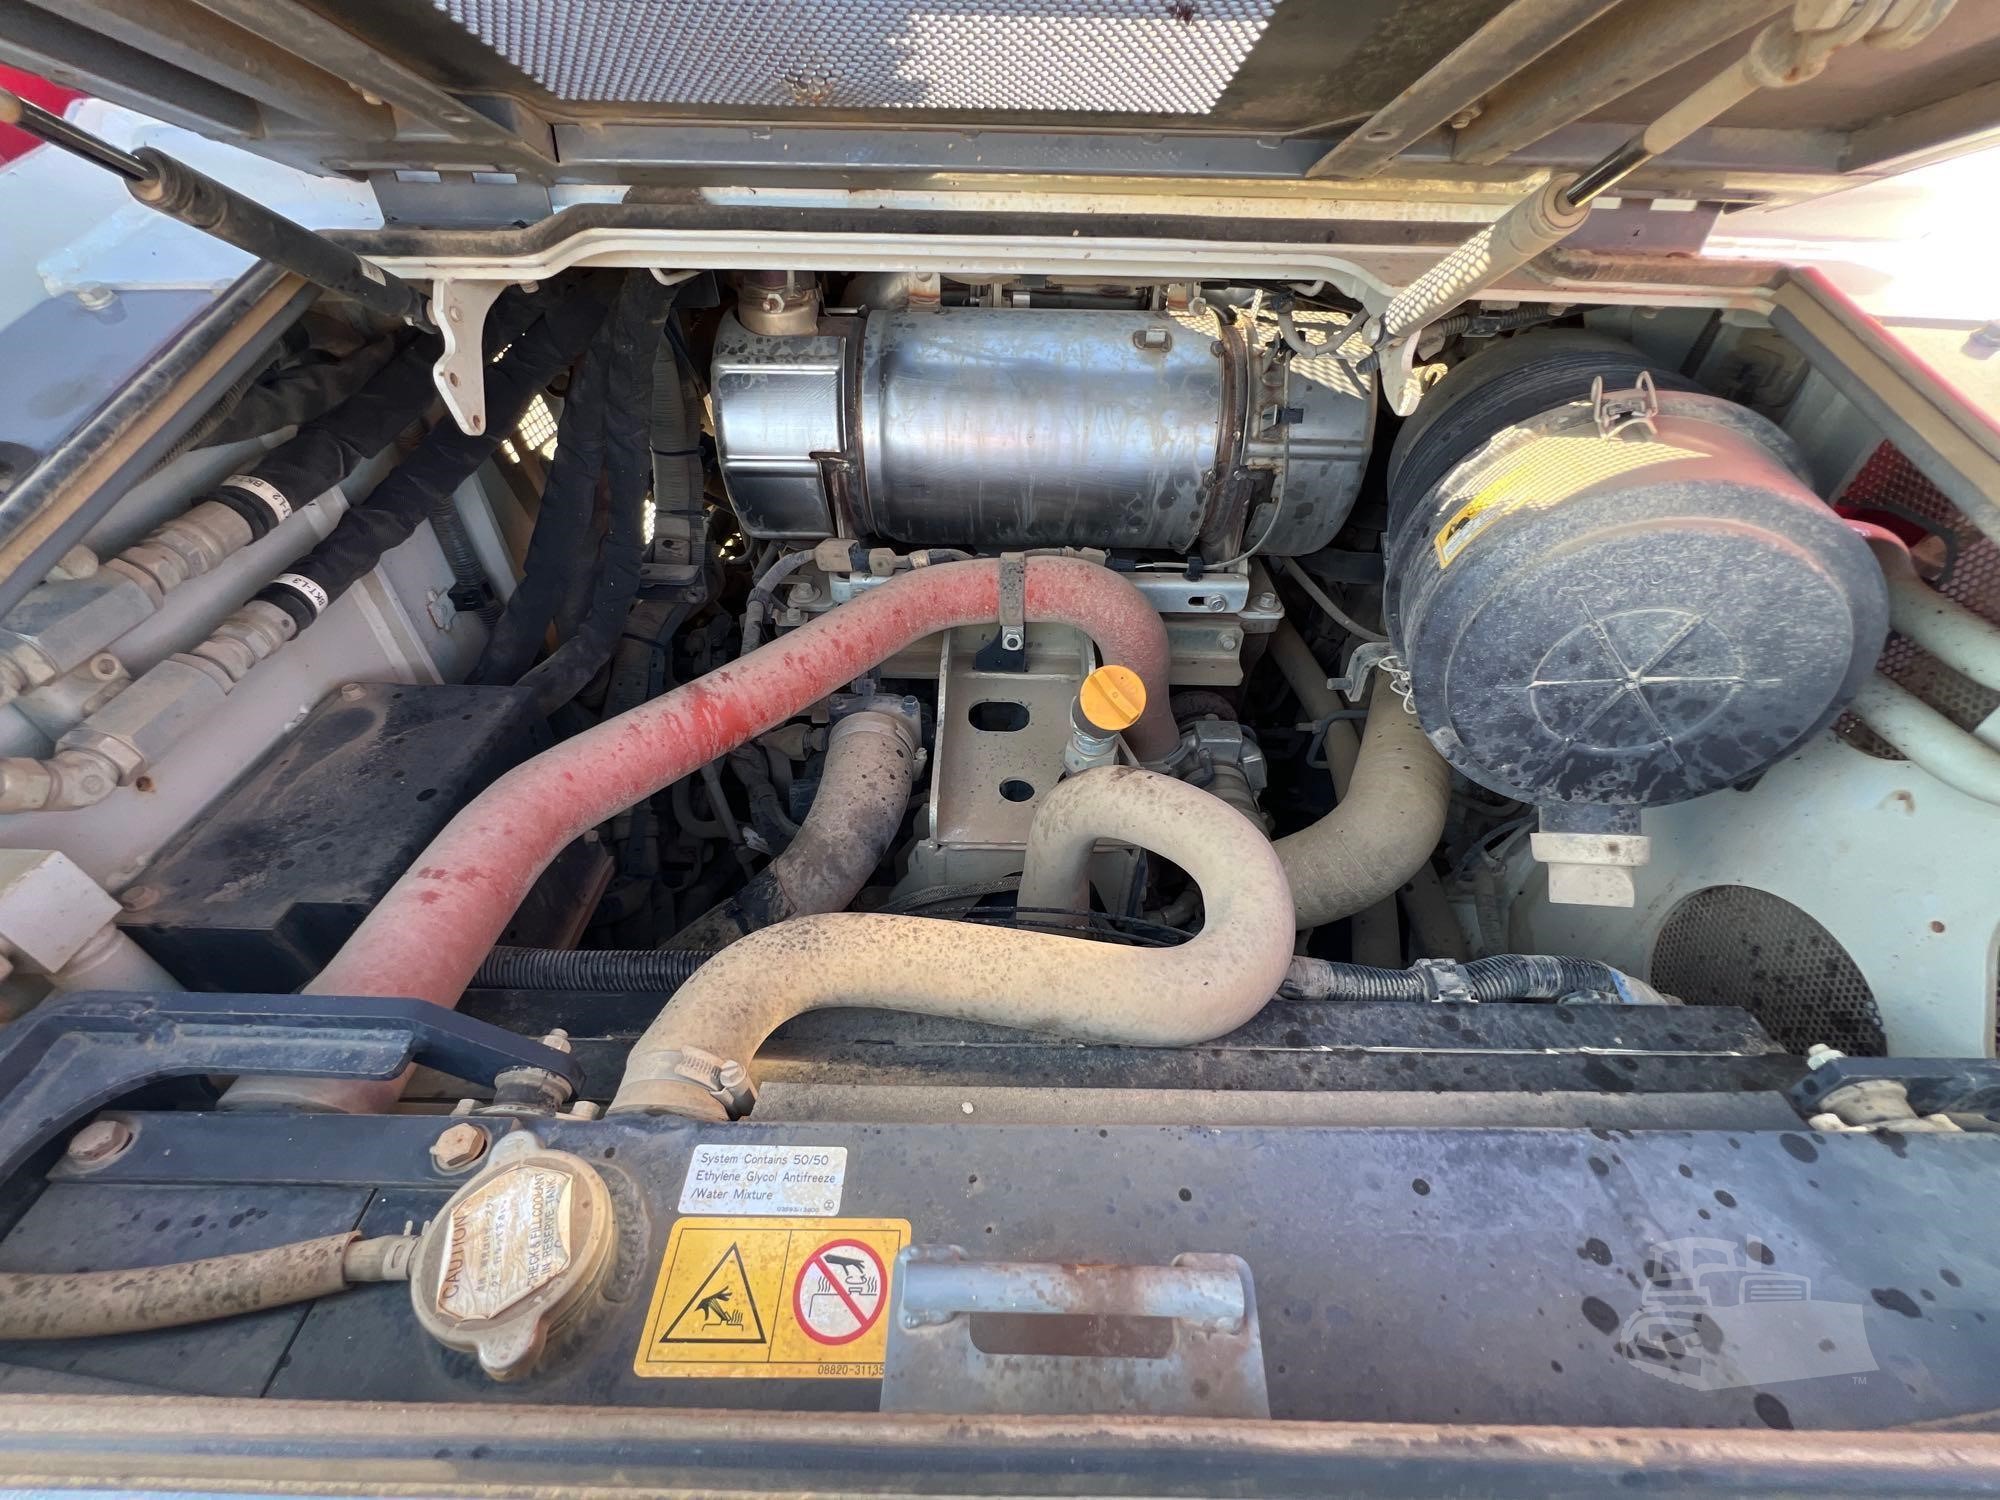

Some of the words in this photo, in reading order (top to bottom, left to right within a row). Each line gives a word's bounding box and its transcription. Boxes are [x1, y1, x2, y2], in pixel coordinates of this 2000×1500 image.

[292, 577, 326, 606] BKT-L3
[701, 1153, 738, 1167] System
[744, 1153, 788, 1165] Contains
[793, 1154, 830, 1166] 50/50
[695, 1169, 741, 1184] Ethylene
[746, 1170, 778, 1183] Glycol
[782, 1172, 836, 1184] Antifreeze
[531, 1173, 544, 1217] COOLANT
[690, 1187, 728, 1200] /Water
[733, 1189, 773, 1200] Mixture
[542, 1208, 555, 1258] RESERVE
[442, 1215, 468, 1299] CAUTION
[817, 1364, 885, 1377] 08820-31135
